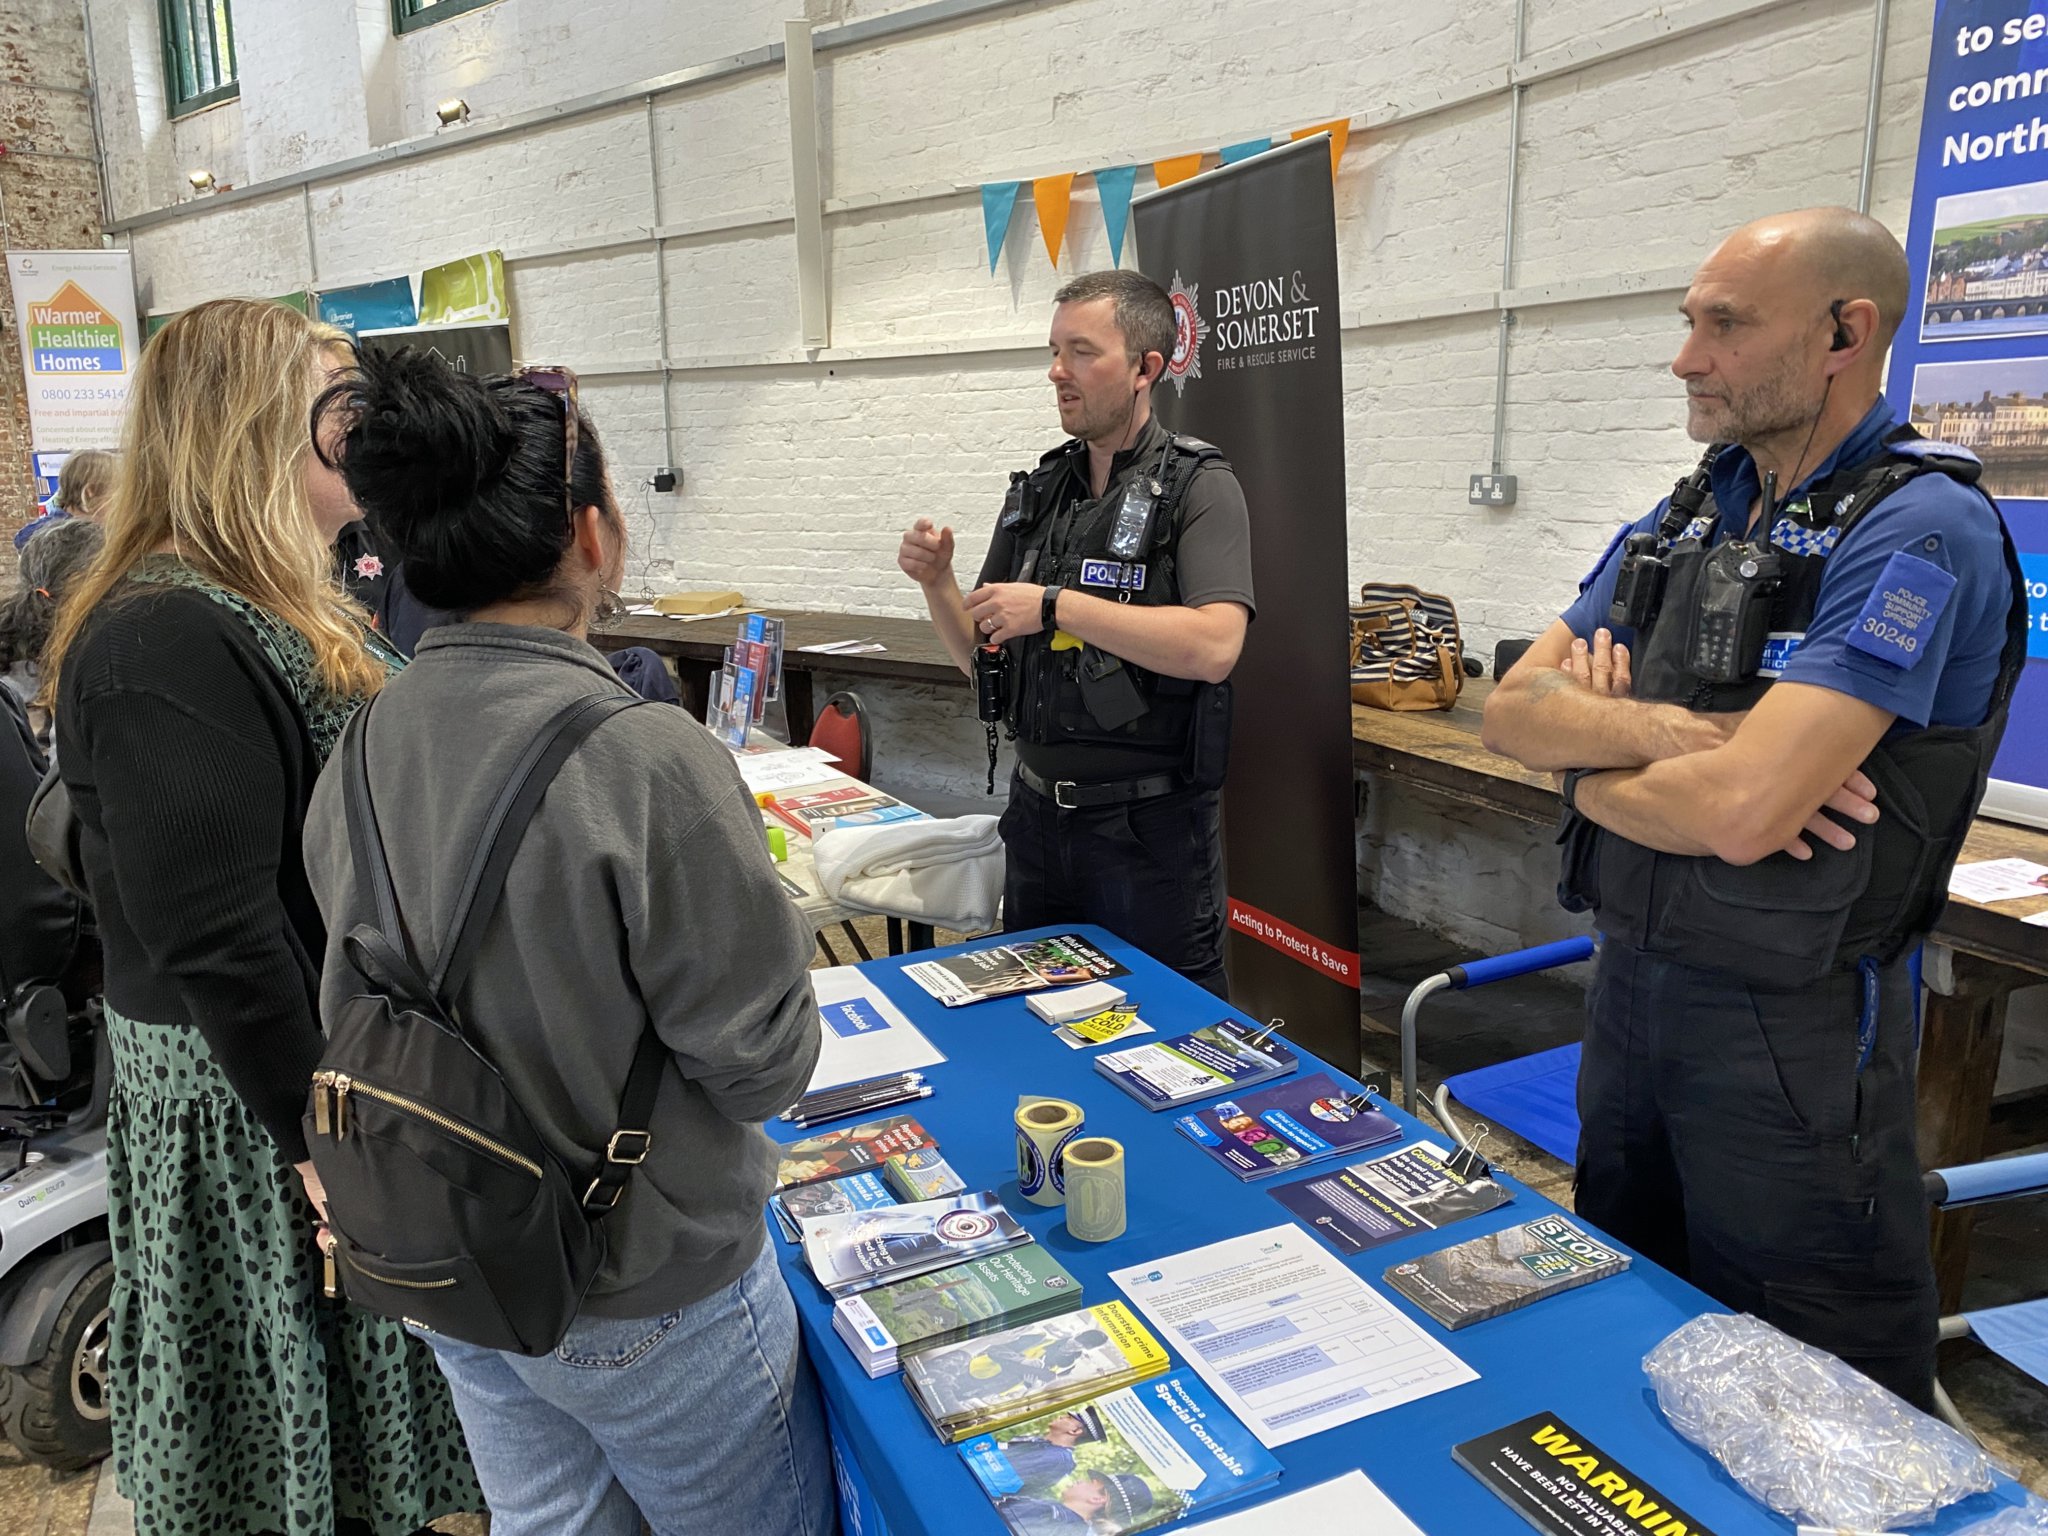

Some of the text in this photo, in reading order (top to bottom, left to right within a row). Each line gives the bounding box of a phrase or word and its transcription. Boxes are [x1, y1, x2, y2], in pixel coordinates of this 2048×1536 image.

[1956, 13, 2048, 57] to se
[1215, 270, 1311, 319] DEVON &
[34, 307, 102, 325] Warmer
[1216, 306, 1319, 351] SOMERSET
[37, 329, 116, 348] Healthier
[40, 353, 102, 370] Homes
[1217, 346, 1316, 371] FIRE & RESCUE SERVICE
[41, 388, 124, 400] 0800 233 5414
[34, 408, 109, 418] Free and impartial
[1882, 590, 1933, 619] COMMUNITY
[1884, 600, 1924, 623] SUPPORT
[1897, 587, 1928, 608] POLICE
[1882, 609, 1918, 631] OFFICER
[1862, 617, 1917, 653] 30249
[1047, 938, 1076, 956] driving
[1071, 954, 1092, 966] cost
[1060, 935, 1116, 970] What will drink
[1232, 908, 1349, 975] Acting to Protect & Save
[840, 1003, 873, 1031] facebook
[1082, 1021, 1117, 1036] CALLERS
[1091, 1017, 1125, 1031] COLD
[1106, 1013, 1127, 1023] NO
[1390, 1157, 1406, 1169] help
[1411, 1171, 1427, 1182] stop
[1399, 1154, 1441, 1181] We need your
[1410, 1148, 1467, 1185] County lines
[861, 1174, 878, 1191] Gone
[1339, 1174, 1417, 1228] What are county lines?
[1539, 1221, 1610, 1260] STOP
[974, 1261, 1000, 1283] Assets
[989, 1257, 1005, 1269] Our
[1000, 1267, 1031, 1296] Heritage
[1002, 1252, 1037, 1285] Protecting
[1095, 1306, 1131, 1349] information
[1106, 1303, 1155, 1359] Doorstep crime
[1169, 1378, 1207, 1419] Become a
[1155, 1383, 1244, 1477] Special Constable
[1500, 1446, 1603, 1528] HAVE BEEN LEFT IN
[1555, 1475, 1641, 1536] NO VALUABLE
